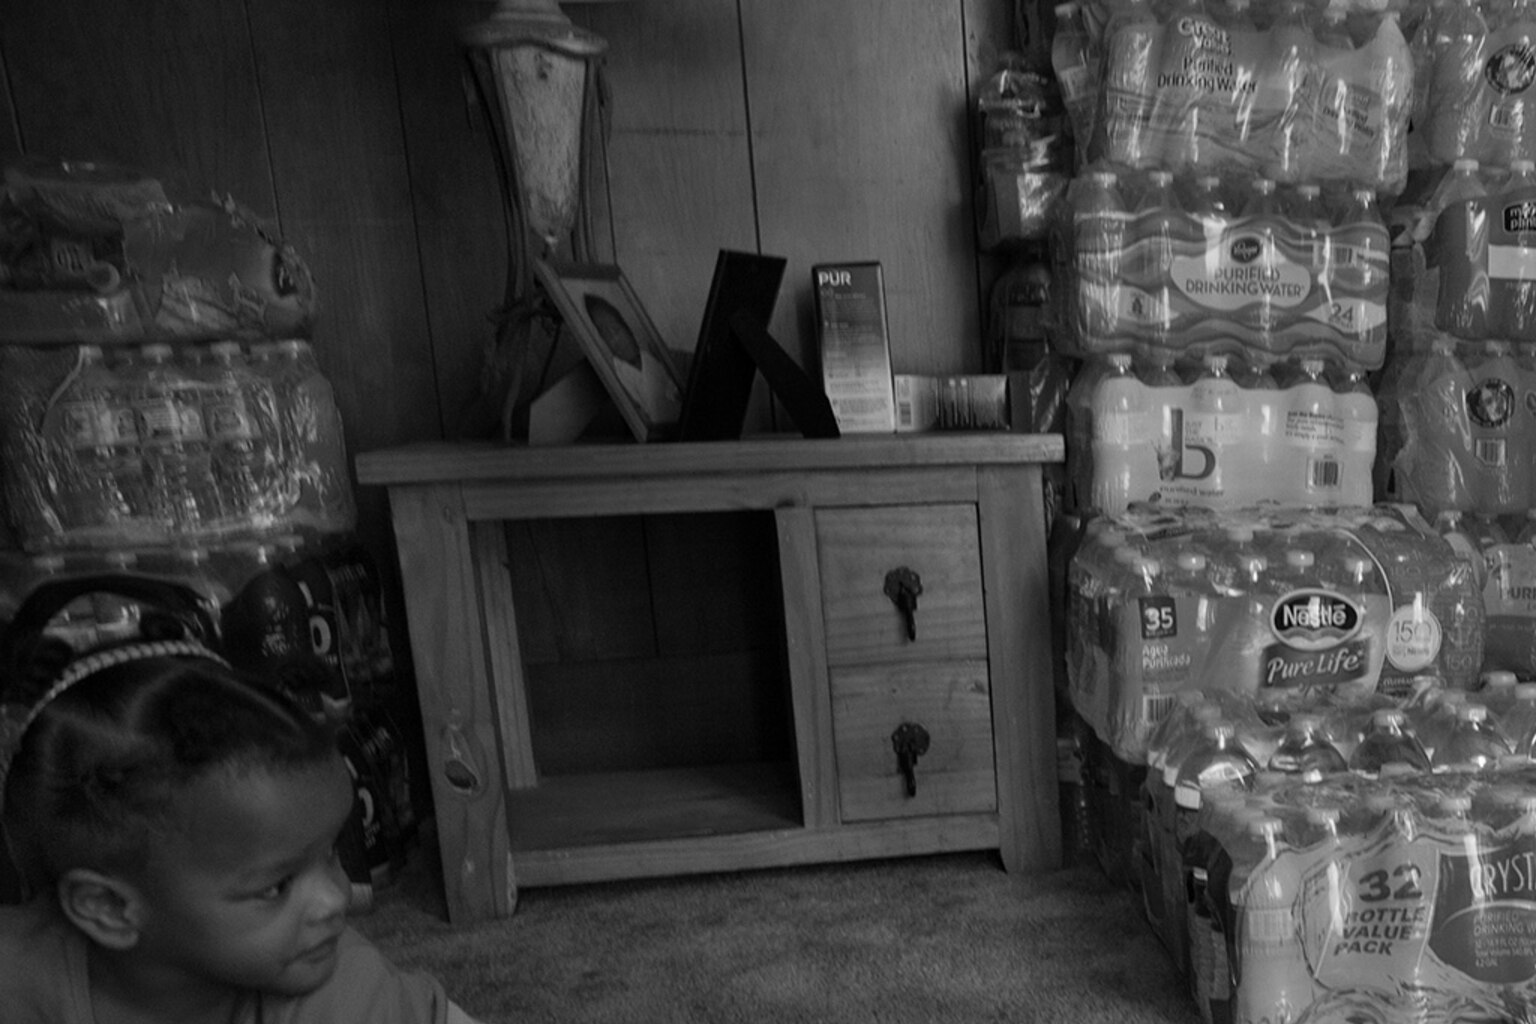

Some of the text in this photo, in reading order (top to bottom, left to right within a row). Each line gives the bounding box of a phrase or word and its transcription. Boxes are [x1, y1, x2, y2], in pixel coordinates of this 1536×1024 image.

[818, 271, 852, 287] PUR
[1185, 279, 1301, 298] DRINKING WATER
[1329, 302, 1354, 322] 24
[1160, 485, 1225, 498] purified water
[1144, 607, 1174, 630] 35
[1266, 647, 1360, 683] Pure Life
[1359, 863, 1423, 902] 32
[1345, 906, 1426, 923] BOTTLE
[1342, 924, 1414, 941] VALUE
[1473, 921, 1524, 938] DRINKING
[1333, 940, 1394, 957] PACK
